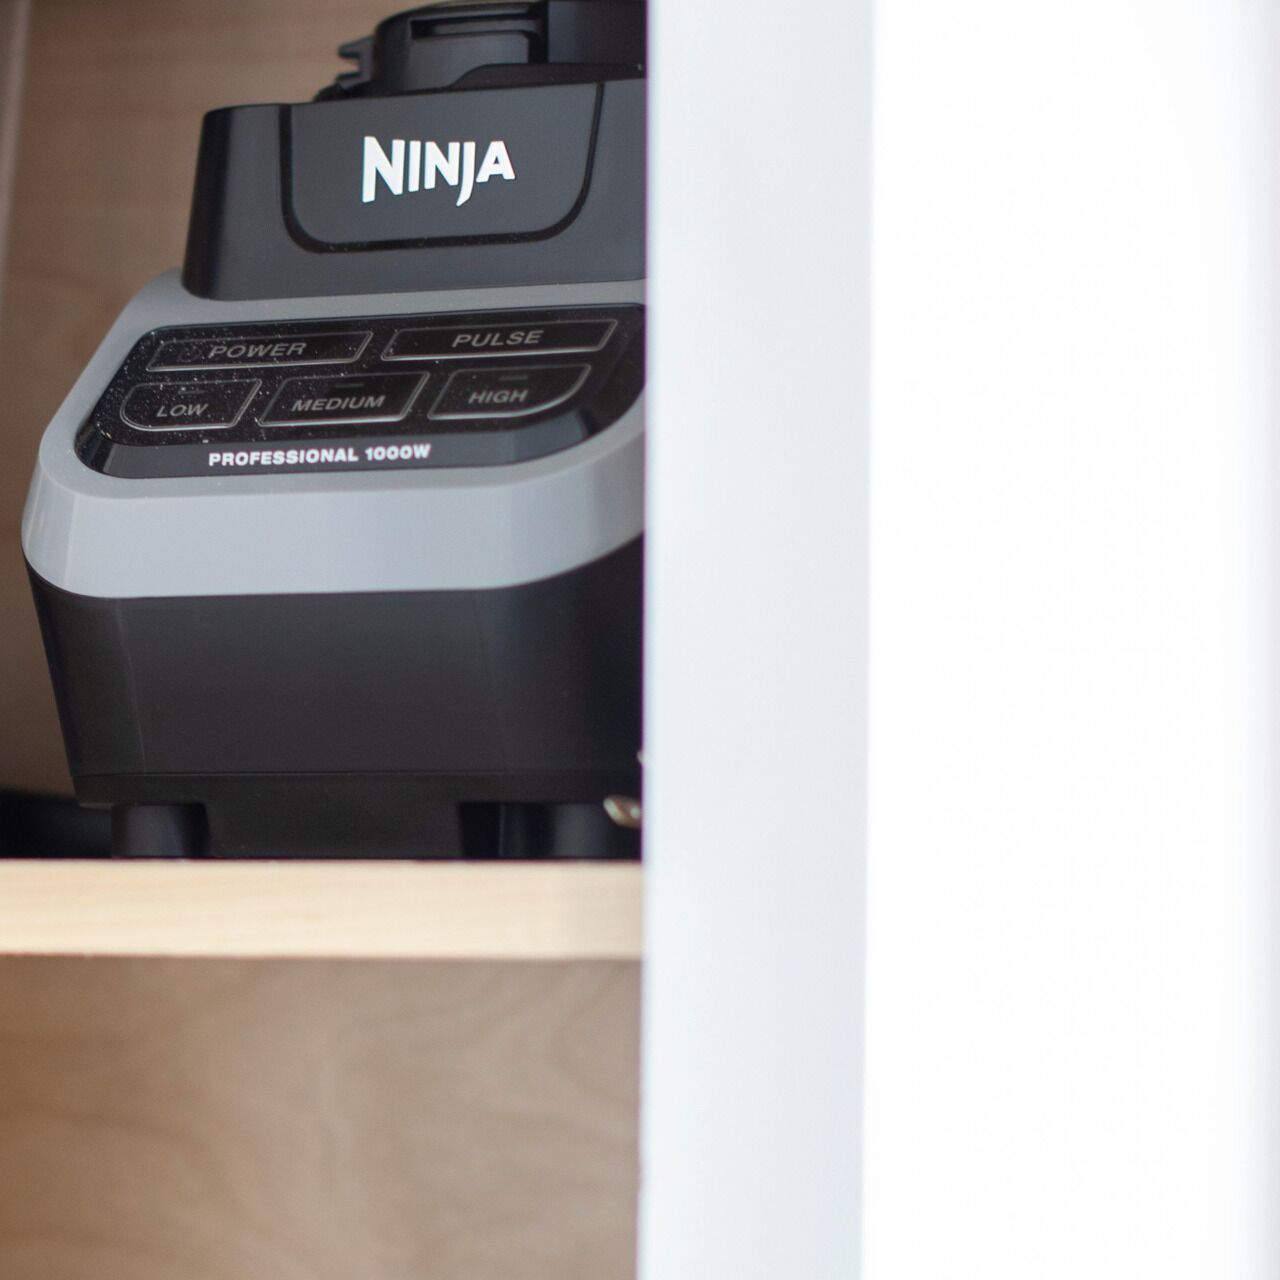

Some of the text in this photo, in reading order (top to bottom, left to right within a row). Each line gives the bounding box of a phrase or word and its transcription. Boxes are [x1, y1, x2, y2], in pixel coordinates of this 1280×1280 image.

[361, 135, 516, 207] NINJA
[452, 330, 545, 349] PULSE
[208, 341, 308, 360] POWER
[291, 395, 386, 413] MEDIUM
[468, 389, 528, 405] HIGH
[157, 403, 209, 418] LOW
[208, 442, 432, 467] PROFESSIONAL 1000W
